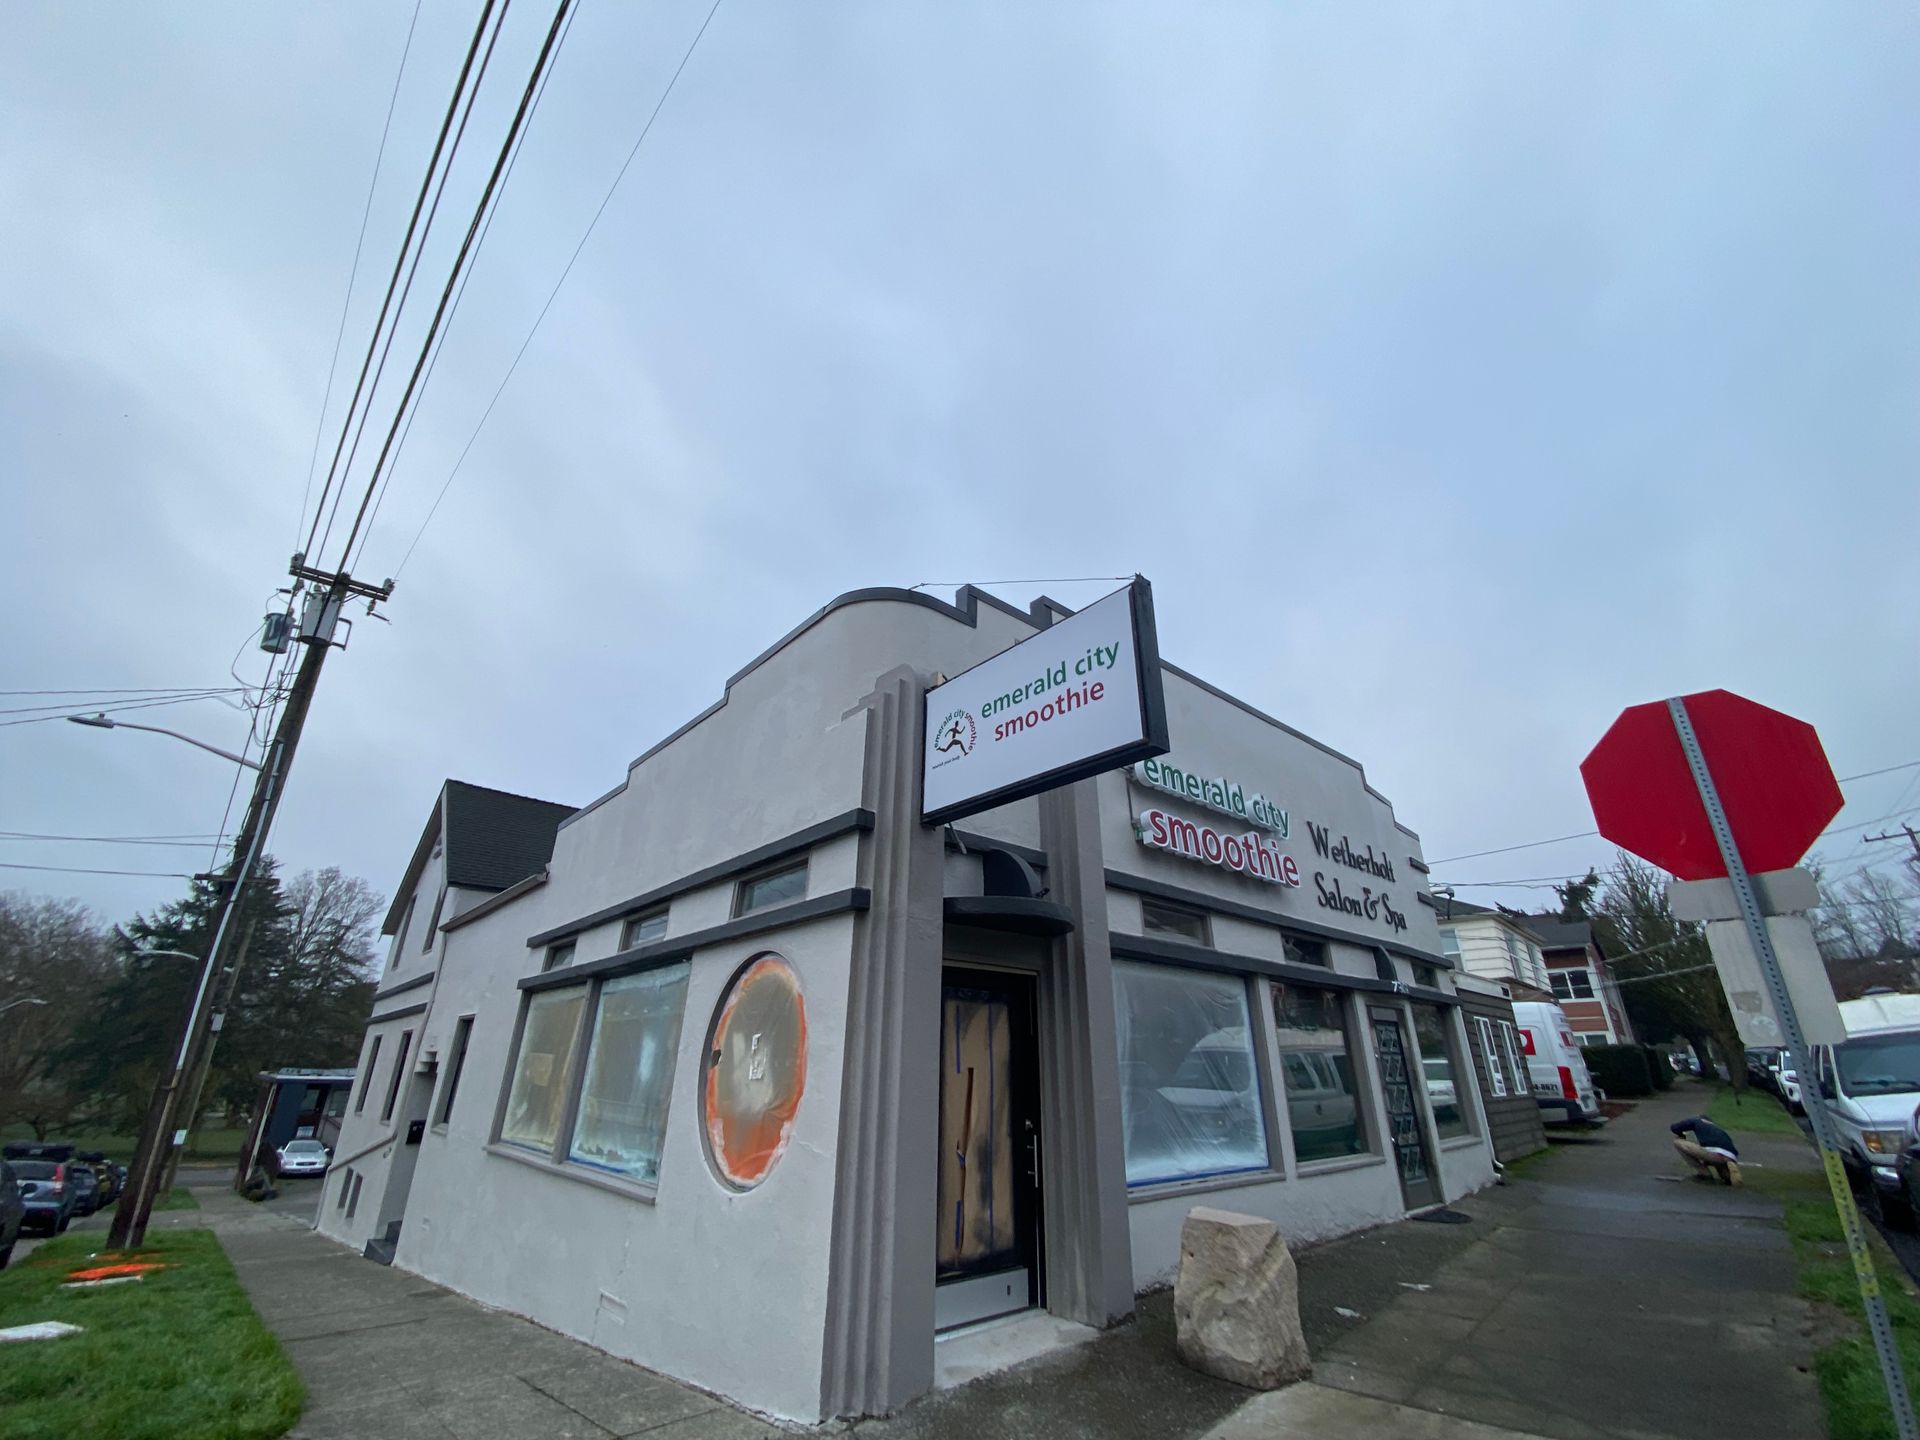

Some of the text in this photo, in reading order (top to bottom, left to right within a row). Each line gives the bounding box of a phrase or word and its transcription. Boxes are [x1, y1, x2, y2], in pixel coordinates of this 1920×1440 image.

[981, 641, 1119, 718] emerald city
[995, 681, 1104, 741] smoothie
[934, 709, 977, 751] emerald city smoothie
[1142, 757, 1289, 838] emerald city
[1148, 809, 1300, 888] smoothie
[1315, 871, 1407, 933] Salon & Spa
